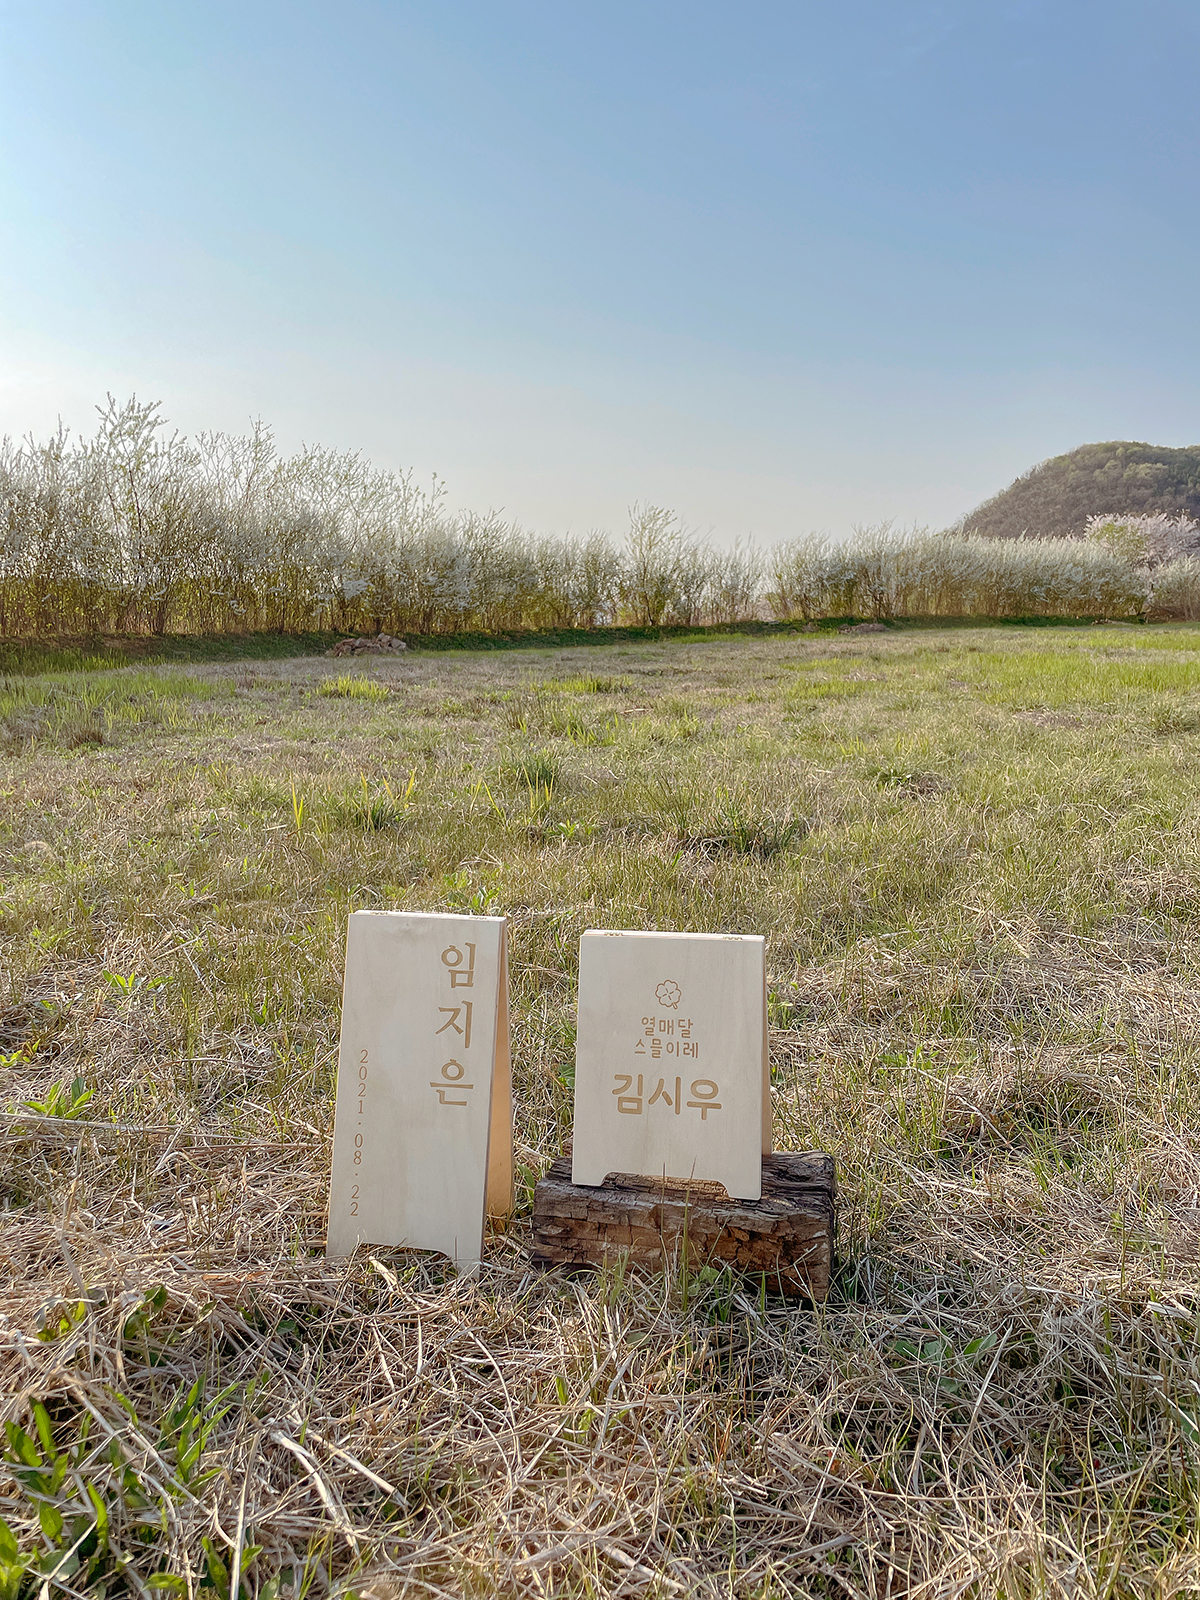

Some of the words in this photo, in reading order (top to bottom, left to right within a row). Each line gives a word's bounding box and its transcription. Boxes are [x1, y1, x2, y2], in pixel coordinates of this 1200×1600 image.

[429, 941, 477, 1107] 임지은
[641, 1016, 694, 1039] 열매달
[611, 1073, 722, 1121] 김시우
